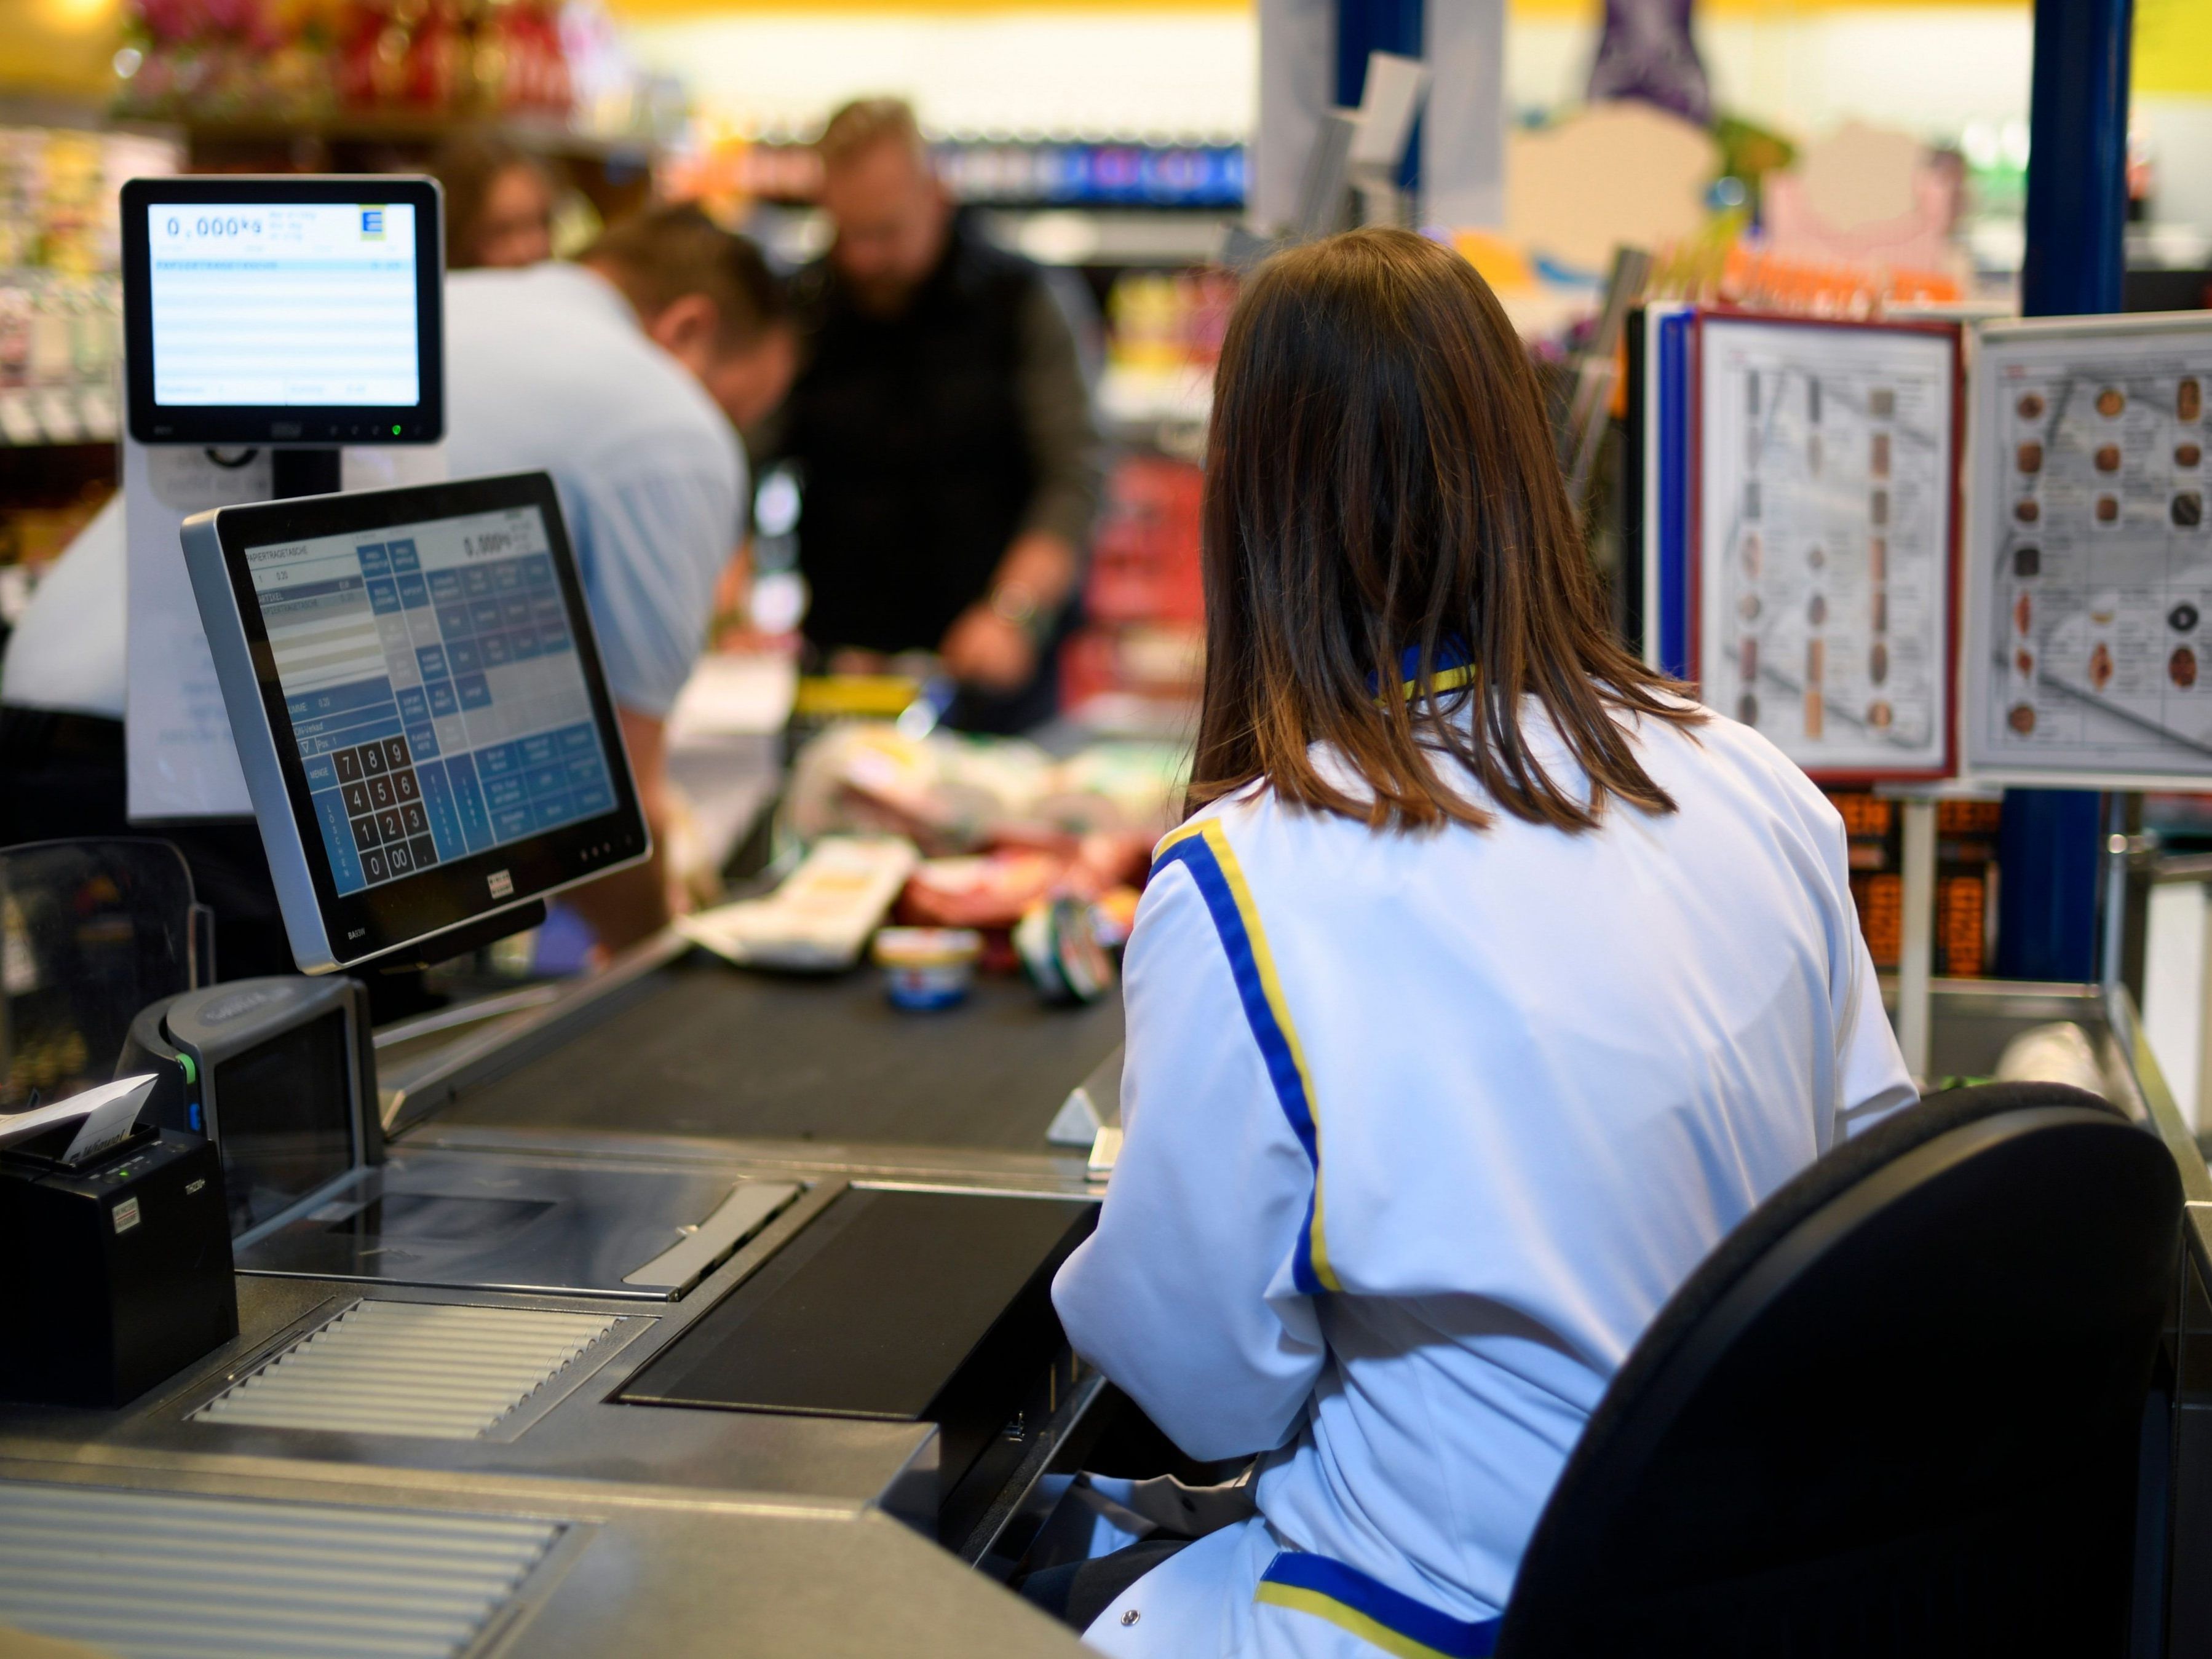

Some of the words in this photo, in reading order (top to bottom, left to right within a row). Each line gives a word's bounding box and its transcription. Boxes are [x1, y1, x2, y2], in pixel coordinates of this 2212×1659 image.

[343, 756, 351, 775] 7
[368, 750, 378, 768] 8
[393, 743, 402, 762] 9
[354, 790, 362, 807] 4
[378, 783, 386, 801] 5
[402, 777, 410, 794] 6
[362, 823, 370, 842] 1
[386, 817, 395, 835] 2
[410, 810, 419, 828] 3
[370, 857, 379, 875] 0
[392, 849, 407, 868] 00
